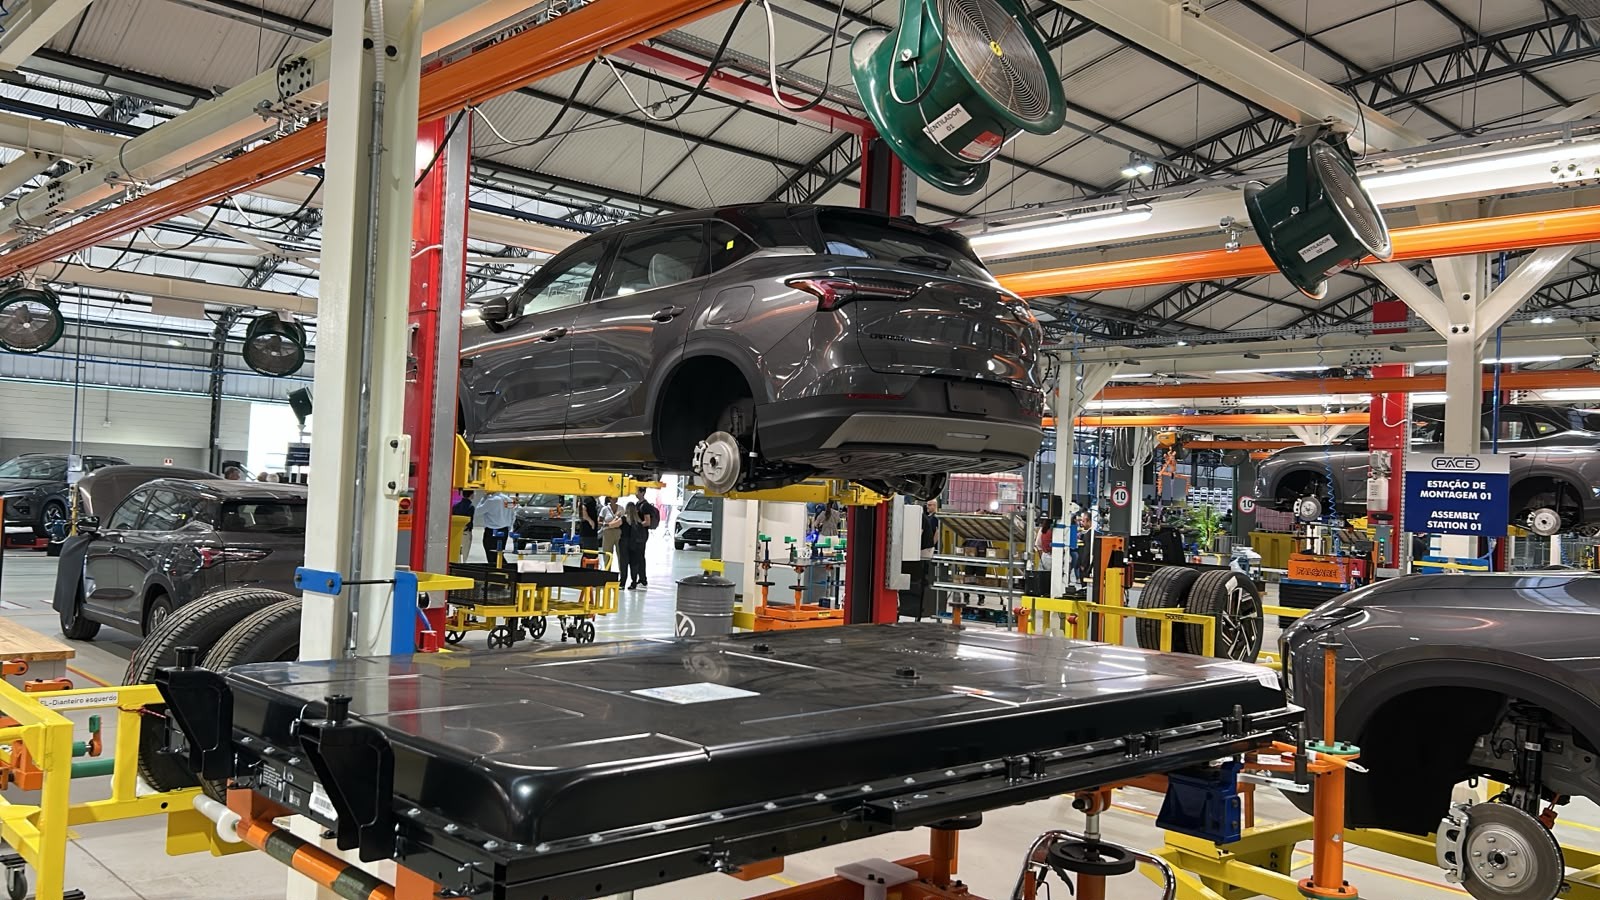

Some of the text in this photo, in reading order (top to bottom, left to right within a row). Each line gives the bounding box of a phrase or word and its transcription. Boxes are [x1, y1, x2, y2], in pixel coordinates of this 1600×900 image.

[946, 124, 955, 132] 01
[1435, 458, 1477, 469] PACE
[1427, 479, 1486, 490] ESTAÇÃO DE
[1115, 491, 1126, 500] 10
[1420, 490, 1492, 500] MONTAGEM 01
[1431, 511, 1480, 520] ASSEMBLY
[1427, 521, 1482, 531] STATION 01
[85, 695, 117, 703] esquerdo
